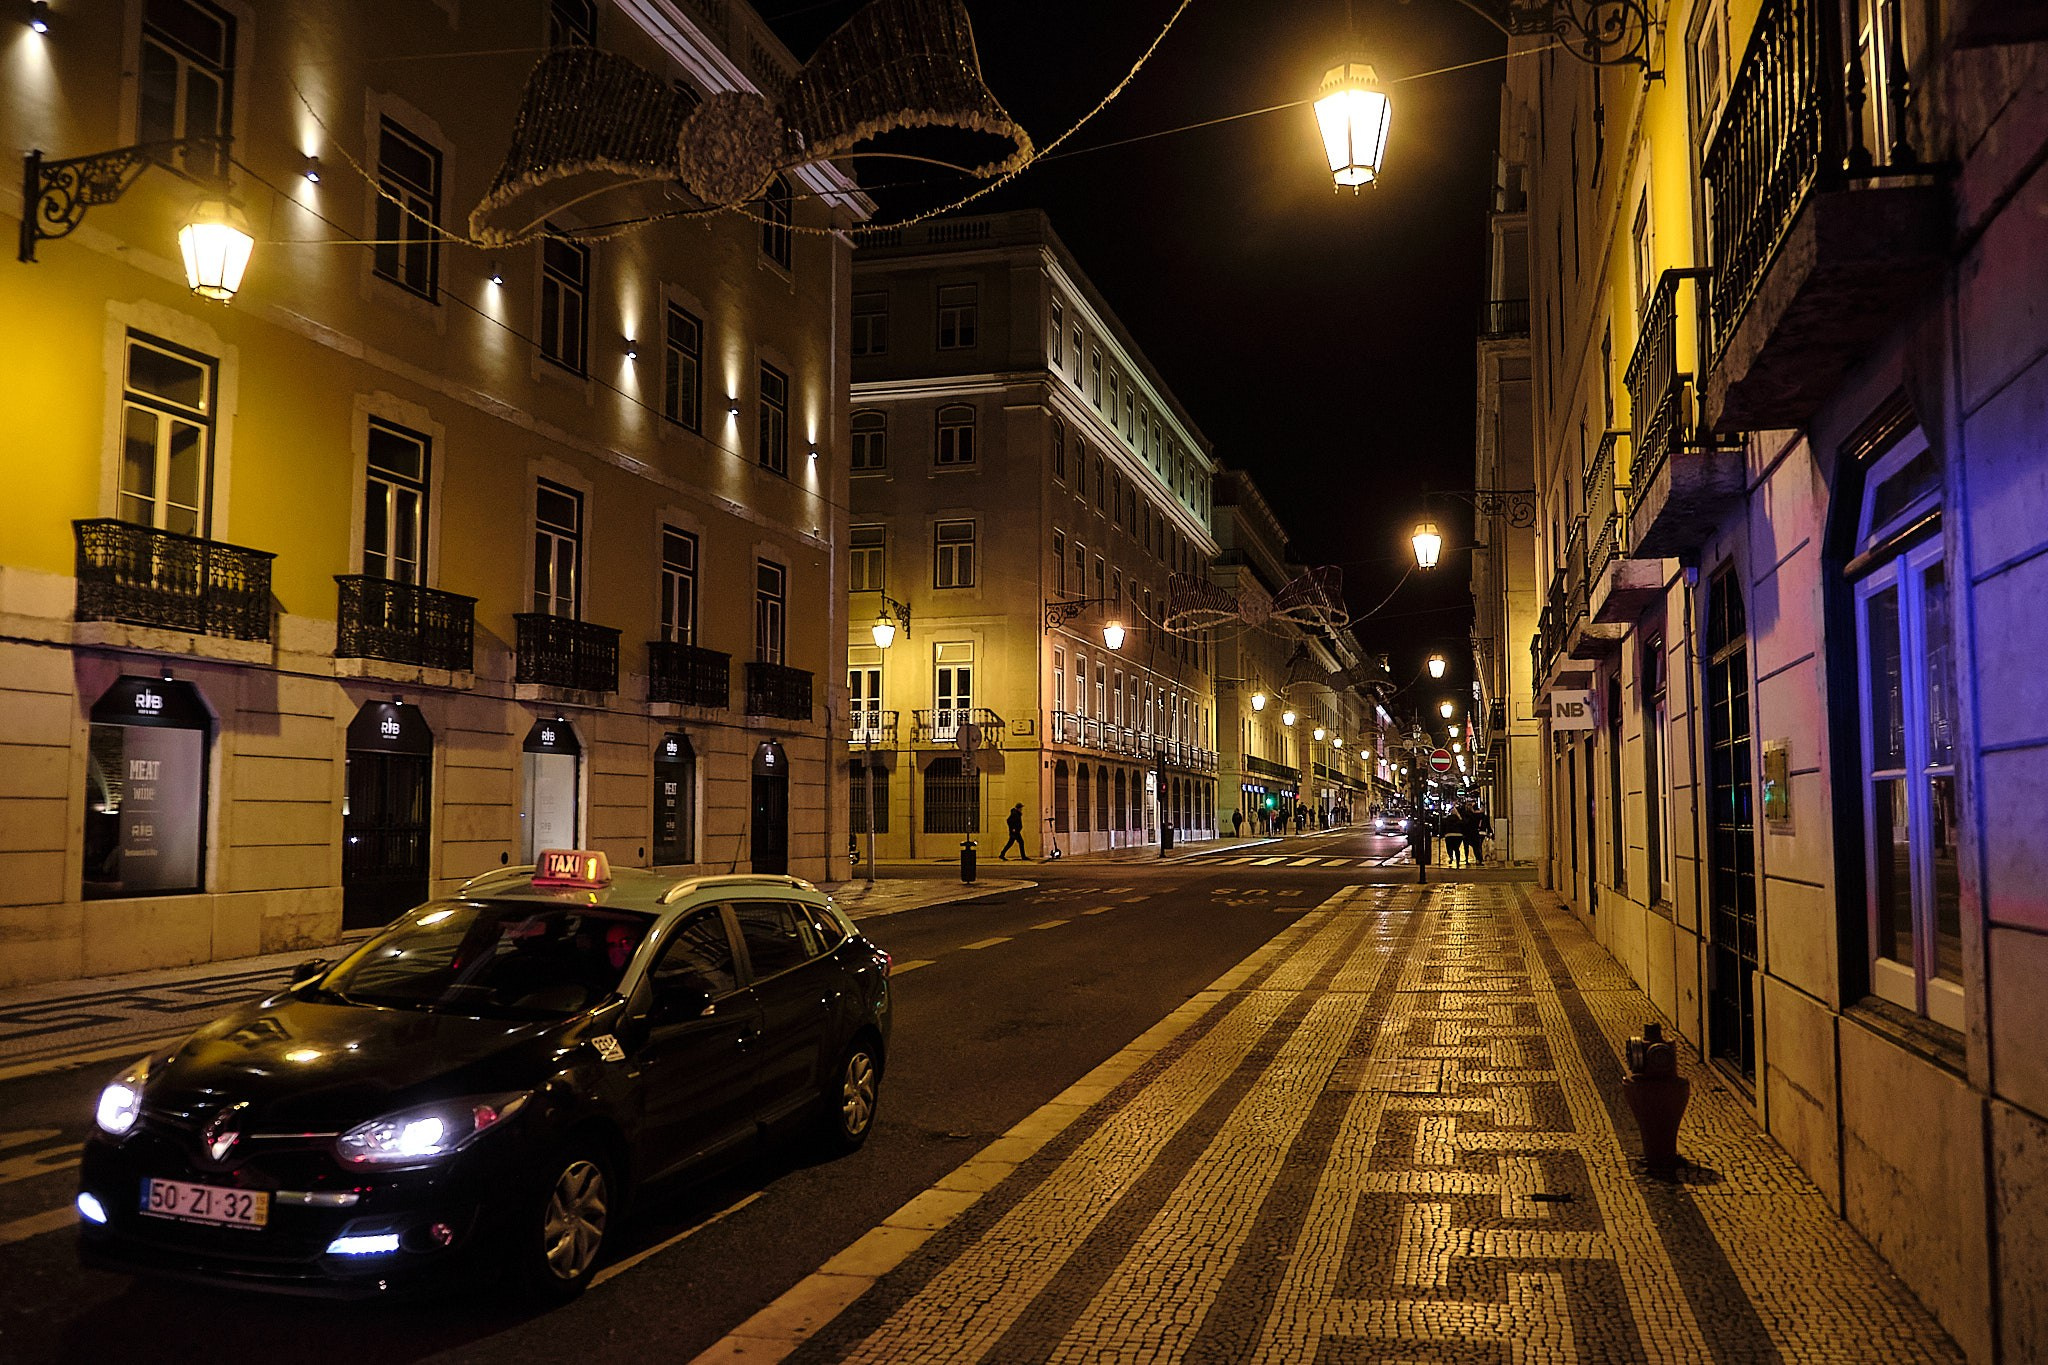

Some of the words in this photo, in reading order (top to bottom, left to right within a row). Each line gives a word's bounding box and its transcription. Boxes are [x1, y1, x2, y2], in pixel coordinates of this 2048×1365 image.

[135, 688, 163, 709] RIB
[1556, 702, 1584, 718] NB
[381, 717, 400, 735] RIB
[541, 727, 556, 742] RIB
[129, 759, 160, 781] MEAT
[131, 821, 153, 837] RIB
[550, 854, 580, 873] TAXI
[587, 857, 597, 880] 1
